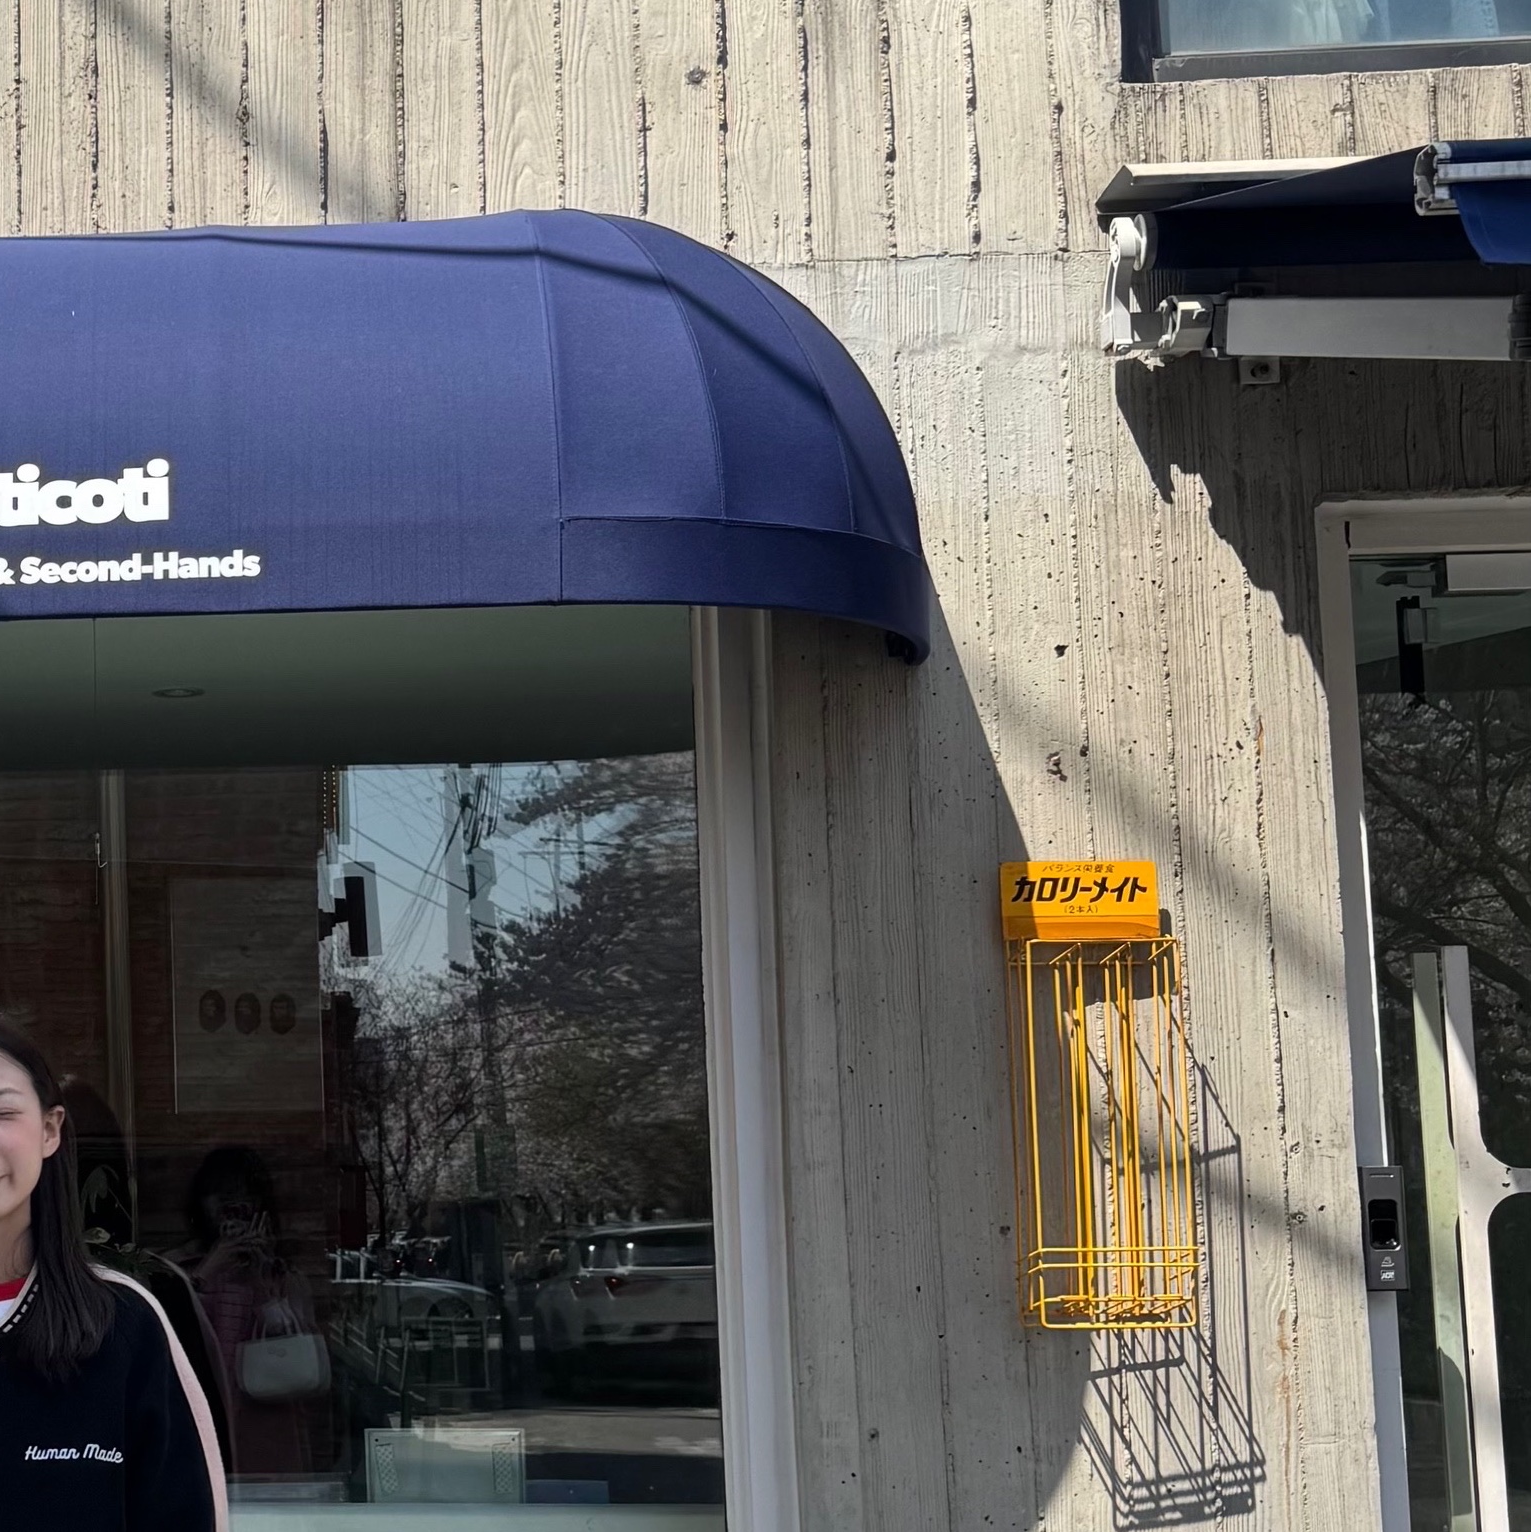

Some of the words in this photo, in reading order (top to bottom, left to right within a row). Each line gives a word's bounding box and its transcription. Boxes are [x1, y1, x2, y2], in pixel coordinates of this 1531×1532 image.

[20, 549, 261, 585] Second-Hands
[1011, 876, 1147, 903] カロリーメイト
[24, 1445, 80, 1461] Human
[83, 1443, 124, 1463] Made
